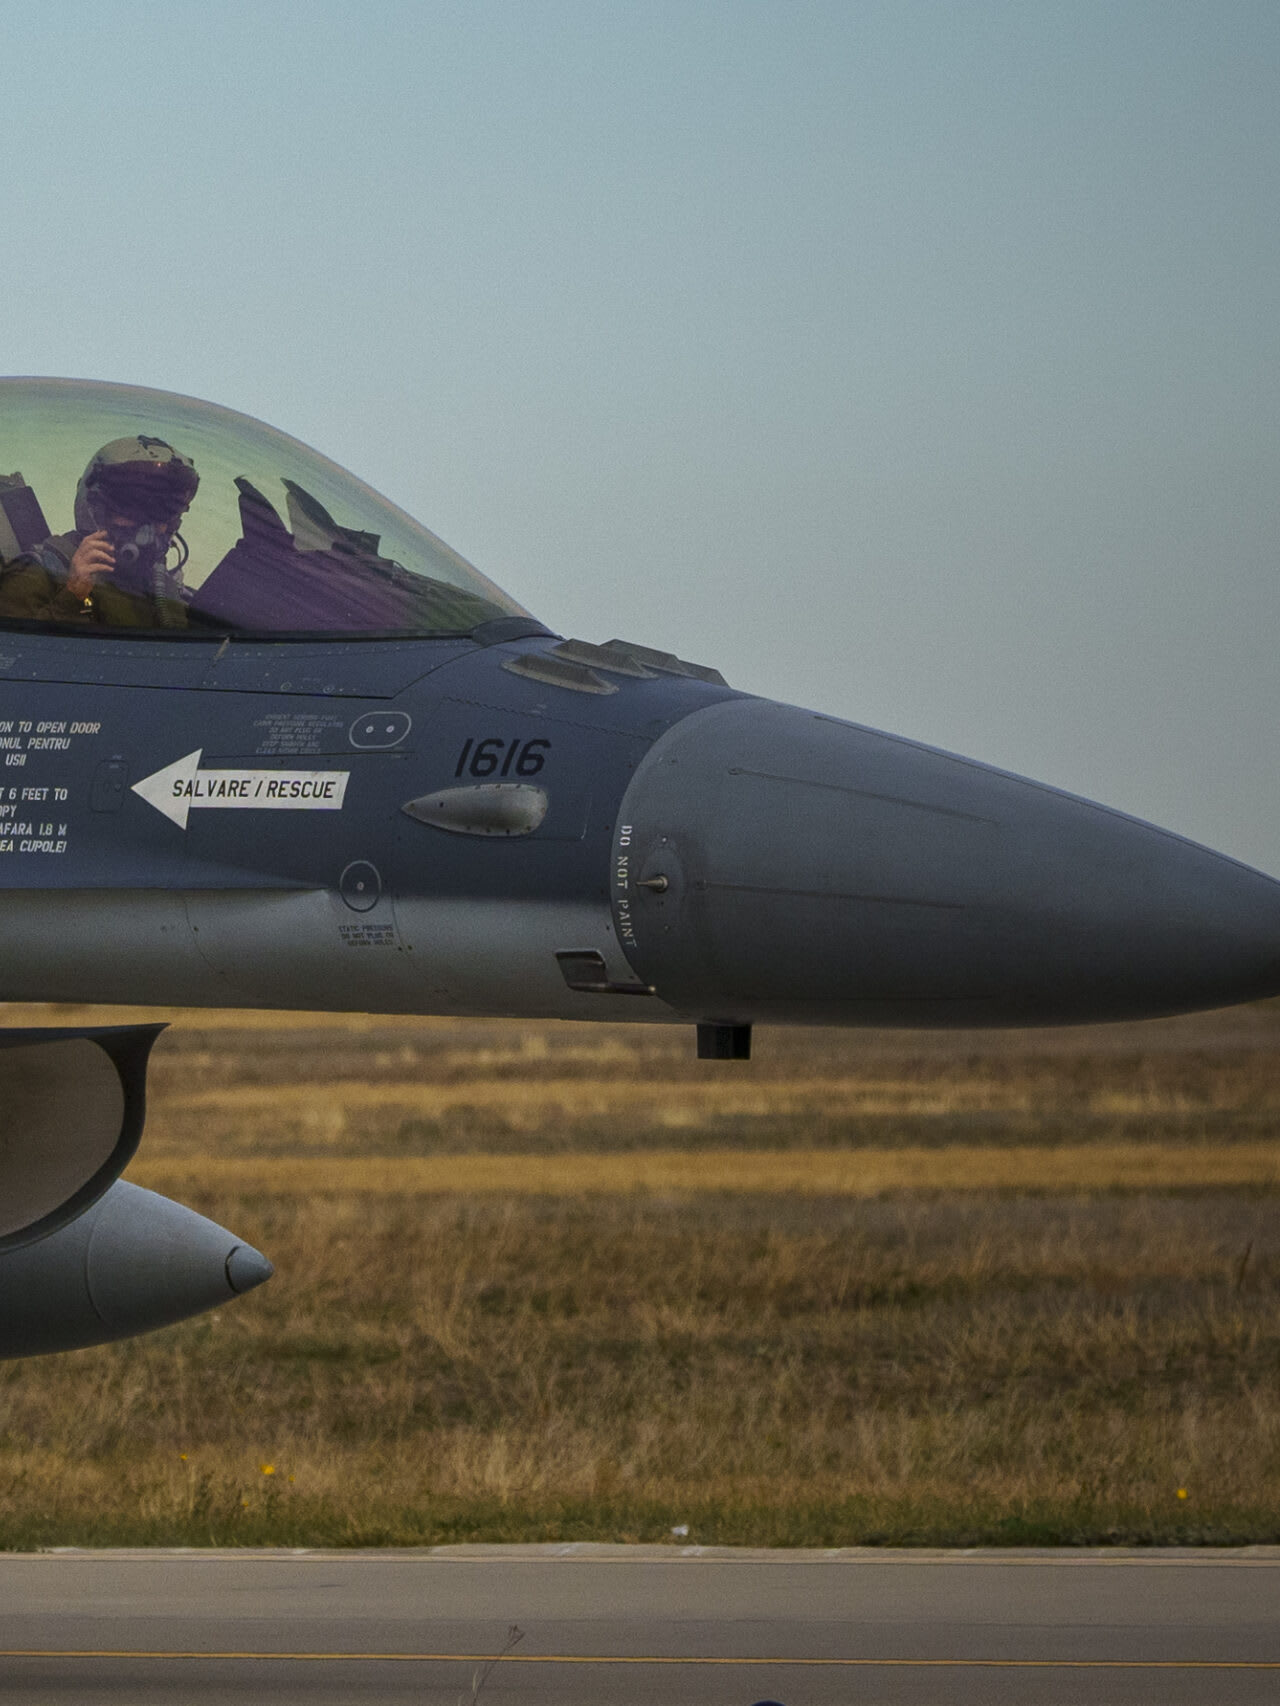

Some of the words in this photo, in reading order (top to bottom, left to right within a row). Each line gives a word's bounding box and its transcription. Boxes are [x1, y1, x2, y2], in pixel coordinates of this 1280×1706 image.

[19, 722, 31, 733] TO
[37, 722, 66, 733] OPEN
[69, 723, 101, 734] DOOR
[27, 738, 70, 750] PENTRU
[5, 754, 27, 766] USII
[454, 738, 552, 777] 1616
[9, 788, 16, 800] 6
[22, 788, 49, 800] FEET
[54, 789, 68, 801] TO
[172, 780, 251, 797] SALVARE
[266, 781, 336, 798] RESCUE
[58, 824, 67, 836] M
[619, 825, 632, 846] DO
[19, 840, 67, 853] CUPOLEI
[617, 856, 629, 889] NOT
[618, 900, 638, 947] PAINT
